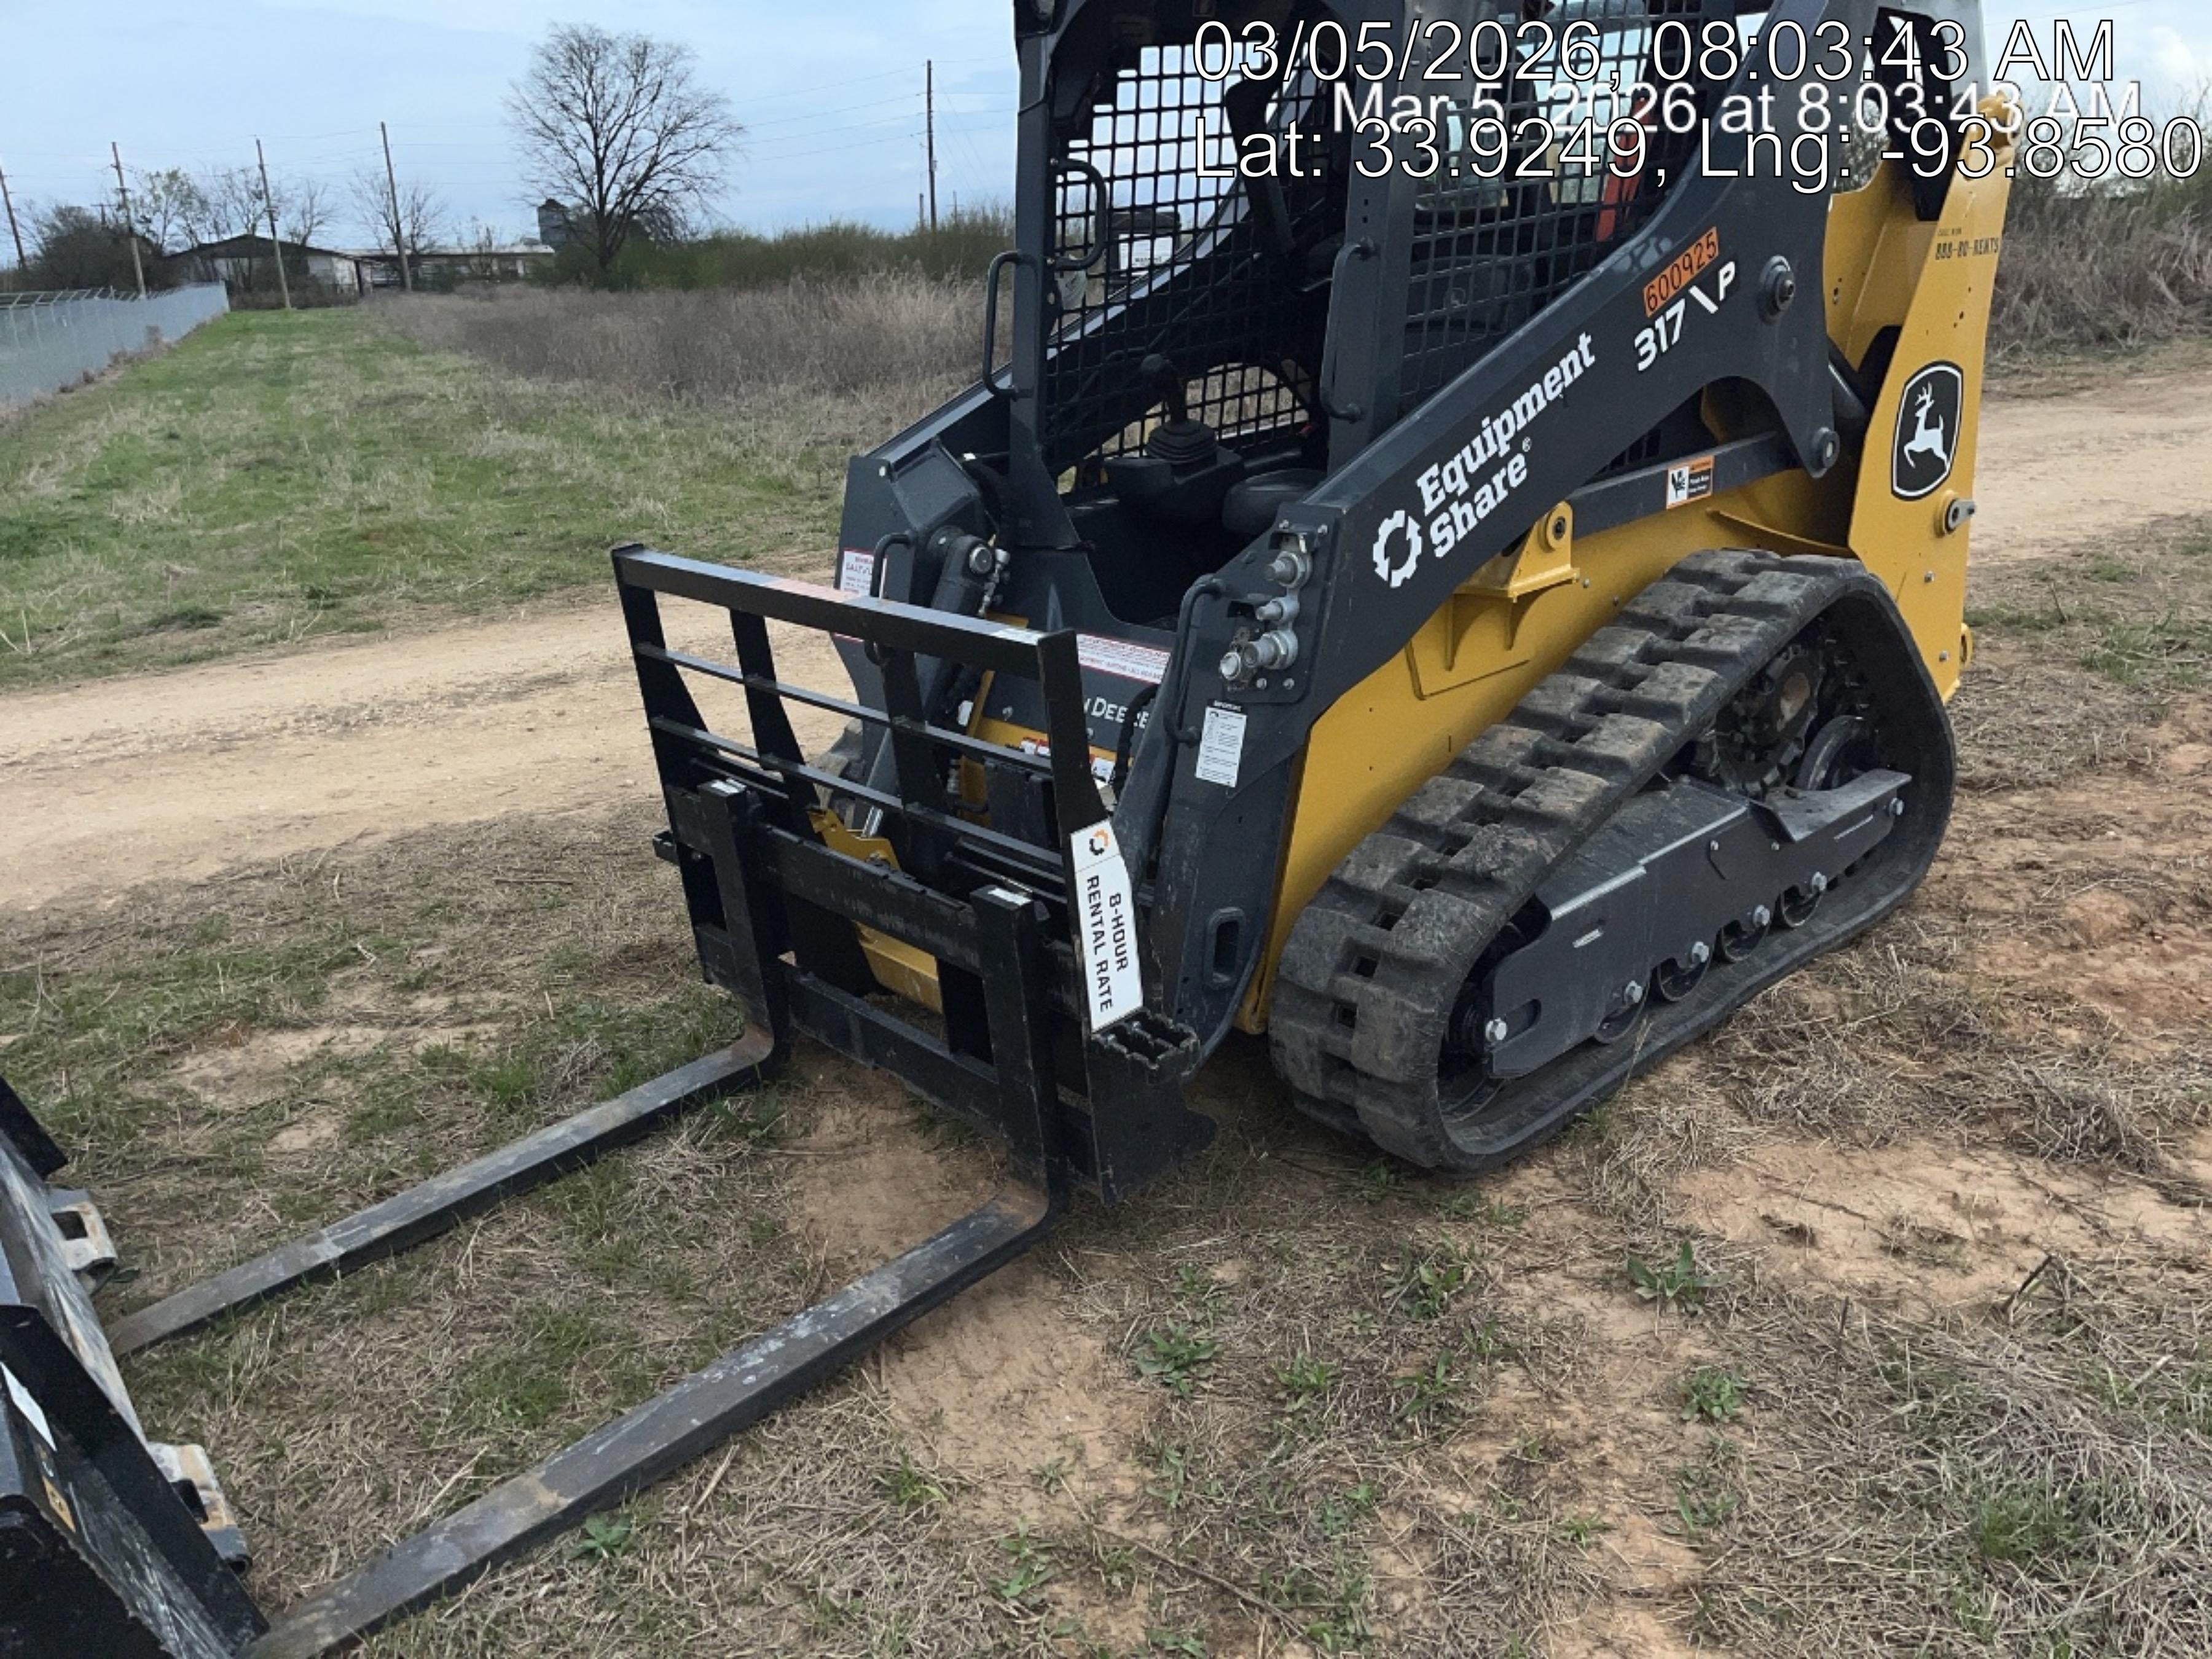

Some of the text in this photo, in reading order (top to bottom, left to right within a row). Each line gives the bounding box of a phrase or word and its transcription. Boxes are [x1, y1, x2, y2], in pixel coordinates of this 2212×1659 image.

[1647, 232, 1717, 311] 600925
[1417, 332, 1595, 516] Equipment
[1087, 875, 1113, 1013] RENTAL RATE
[1109, 893, 1129, 972] 8-HOUR
